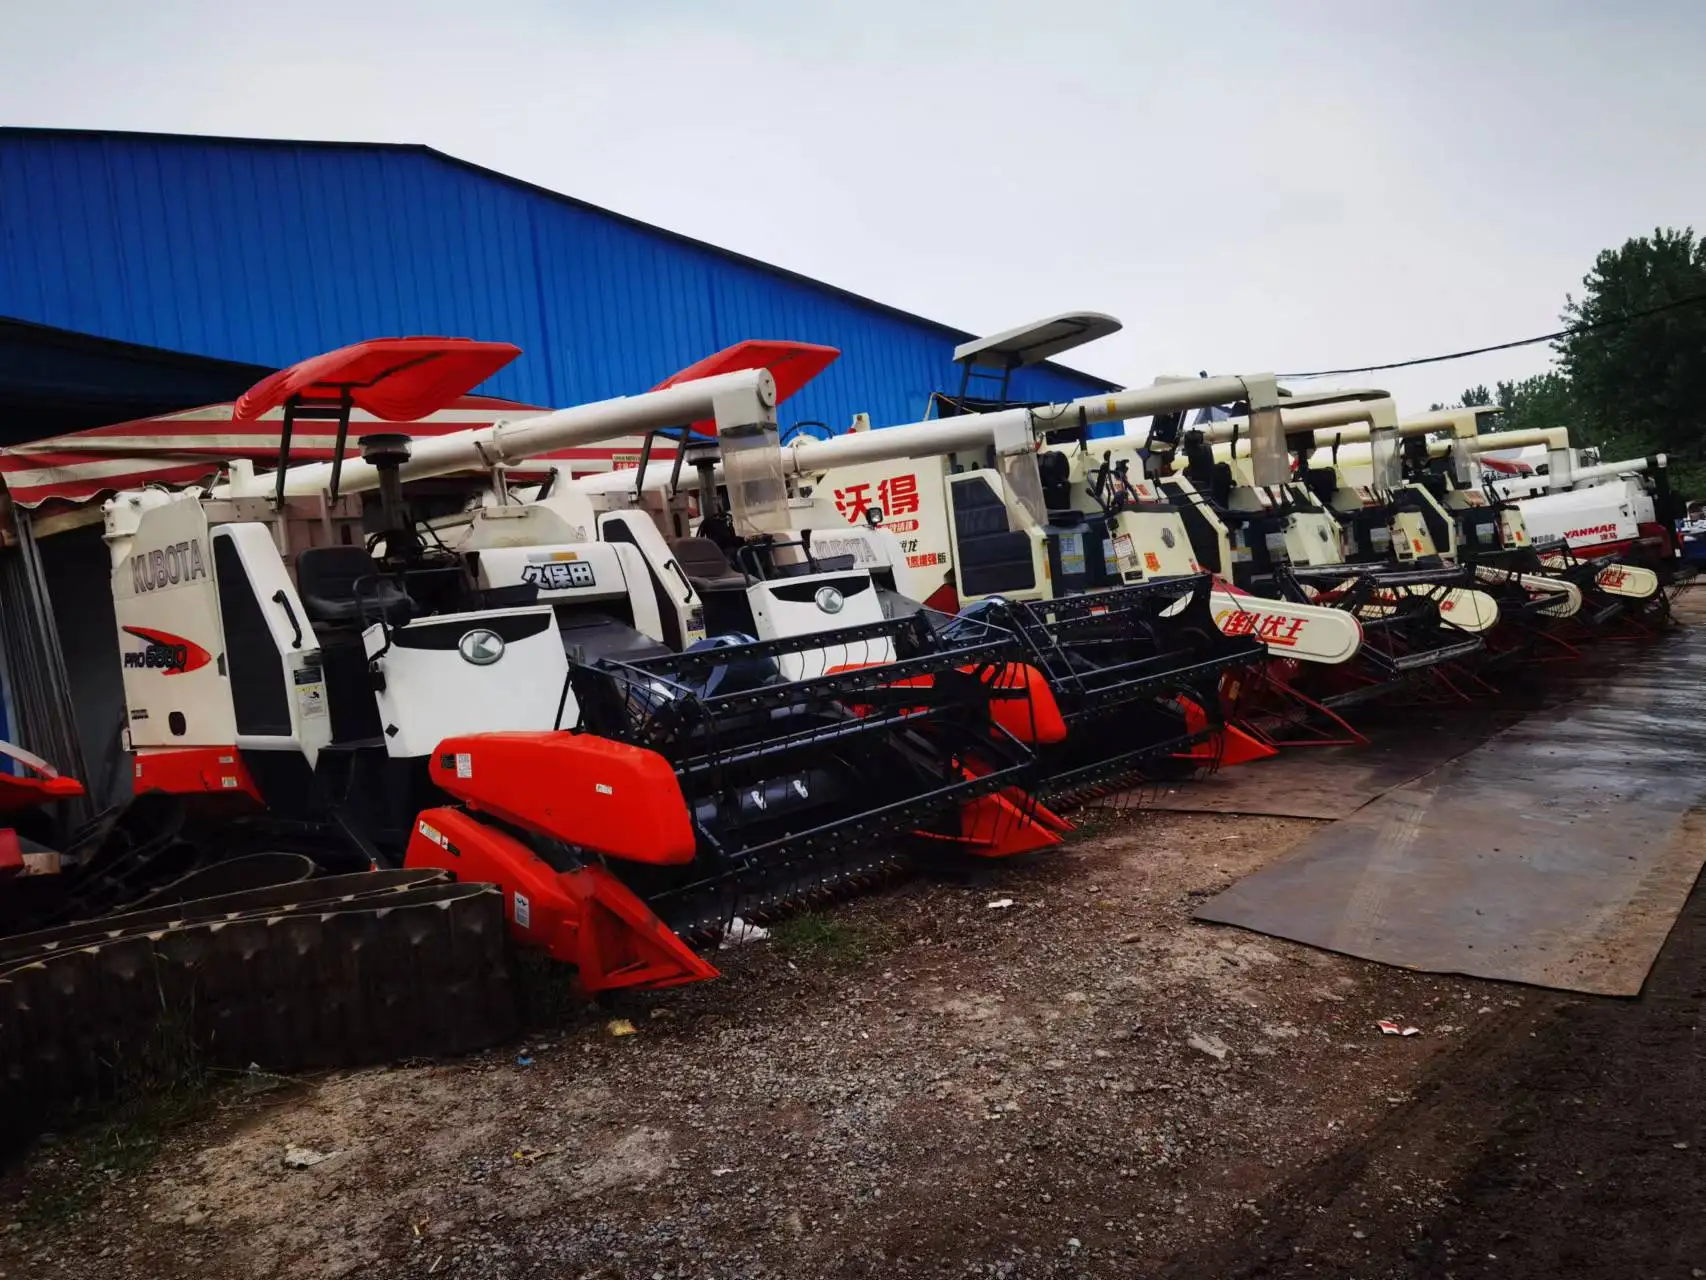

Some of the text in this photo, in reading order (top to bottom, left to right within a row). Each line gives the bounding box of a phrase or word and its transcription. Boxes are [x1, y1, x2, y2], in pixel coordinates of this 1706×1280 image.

[833, 474, 919, 524] 沃得
[1563, 523, 1617, 539] YANMAR
[130, 538, 206, 594] KUBOTA
[521, 561, 596, 591] 久保田
[1222, 610, 1309, 640] 倒伏王
